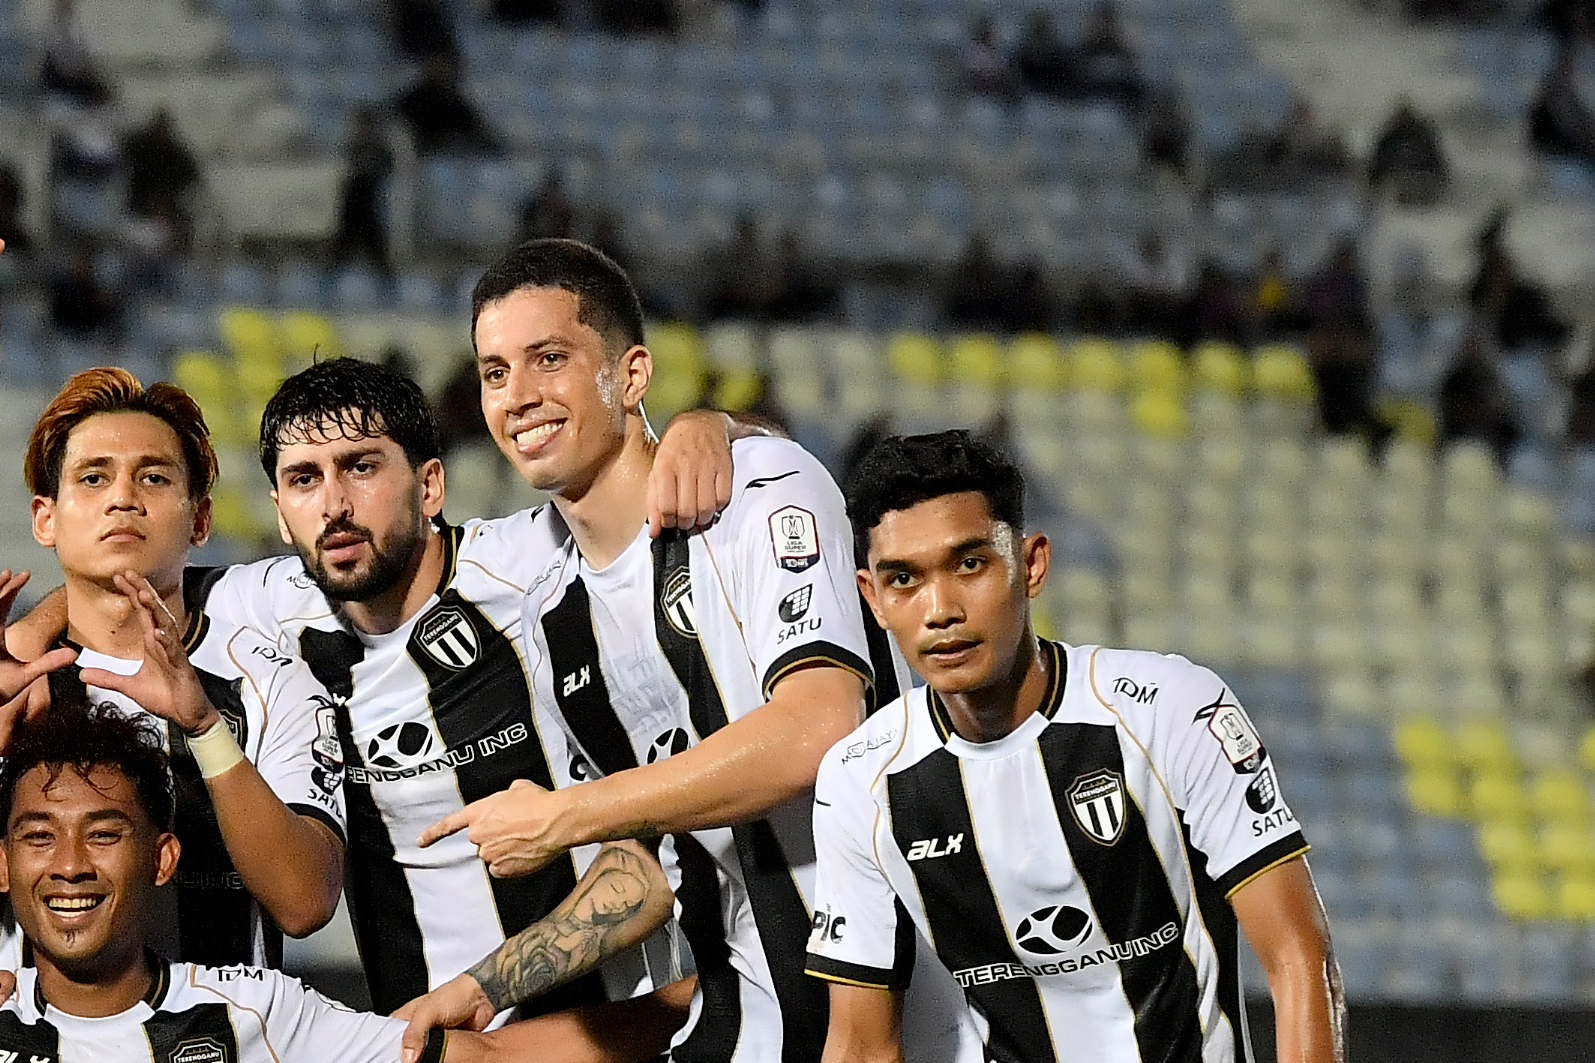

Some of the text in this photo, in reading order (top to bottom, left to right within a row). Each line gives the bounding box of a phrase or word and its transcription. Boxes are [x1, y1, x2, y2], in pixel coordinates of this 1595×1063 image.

[777, 617, 822, 645] SATU
[479, 723, 528, 757] INC
[953, 921, 1180, 989] TERENGGANU INC
